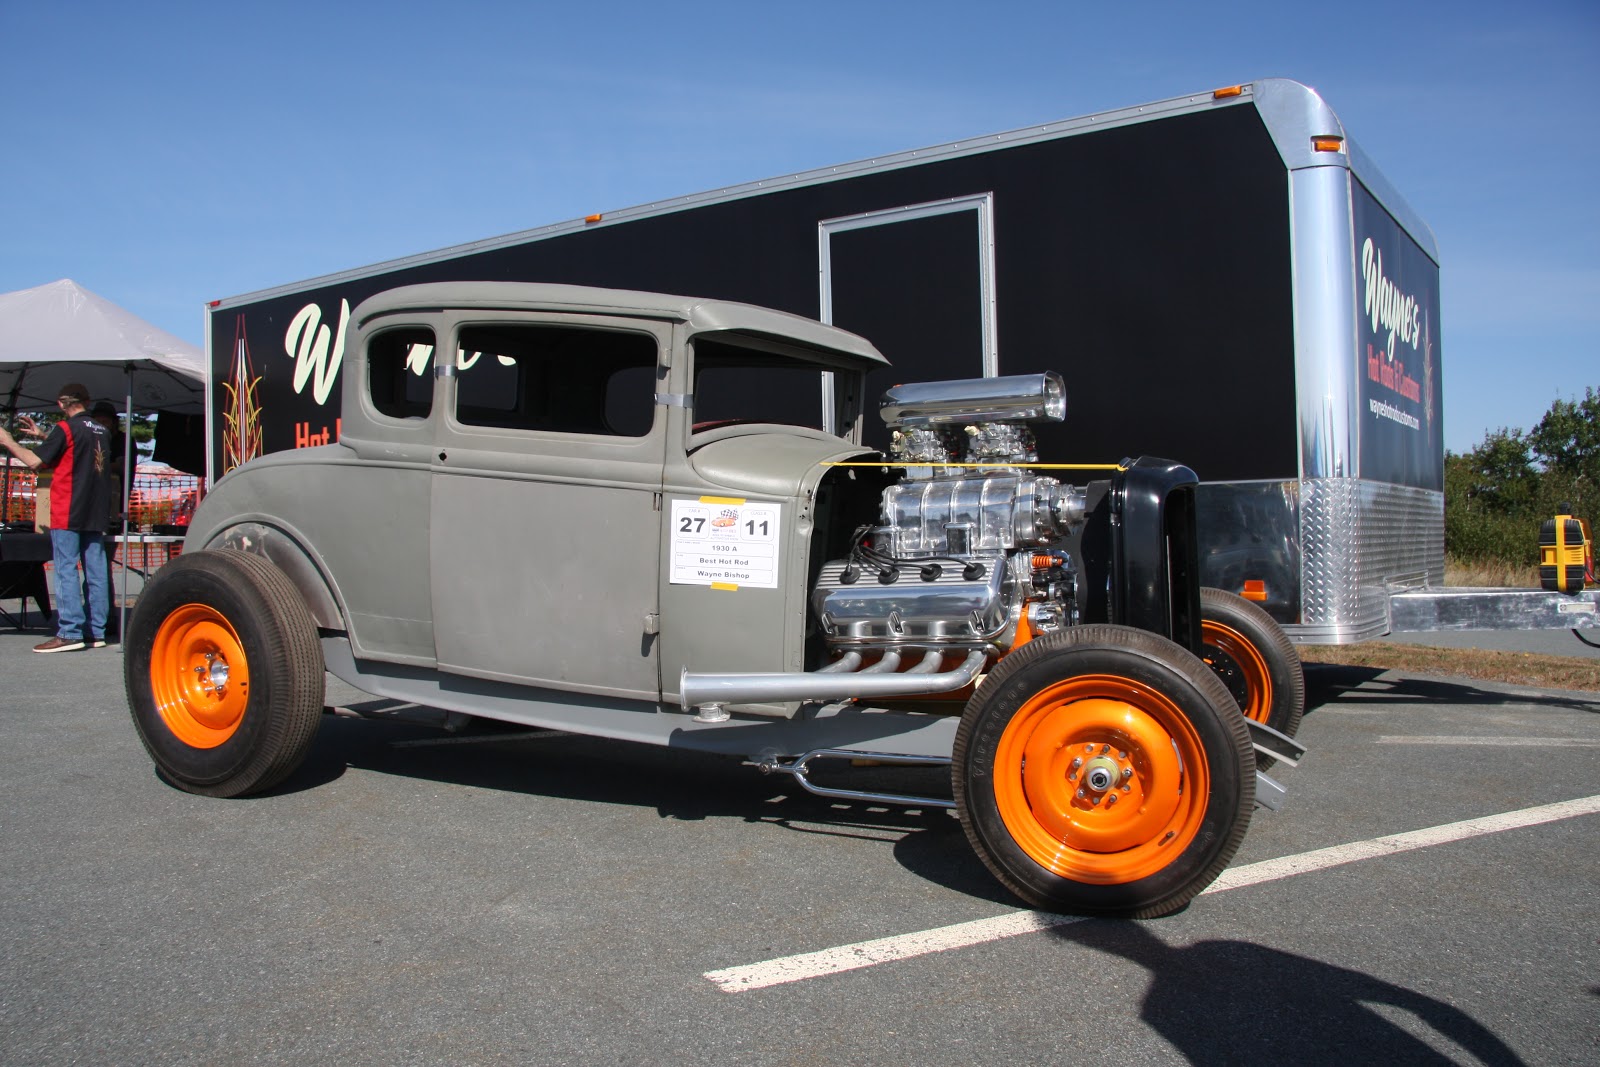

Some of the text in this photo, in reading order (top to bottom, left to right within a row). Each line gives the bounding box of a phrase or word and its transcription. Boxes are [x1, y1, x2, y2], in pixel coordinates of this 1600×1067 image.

[1362, 237, 1420, 362] Wayne's
[680, 517, 706, 533] 27
[745, 520, 768, 536] 11
[697, 570, 722, 578] Wayne
